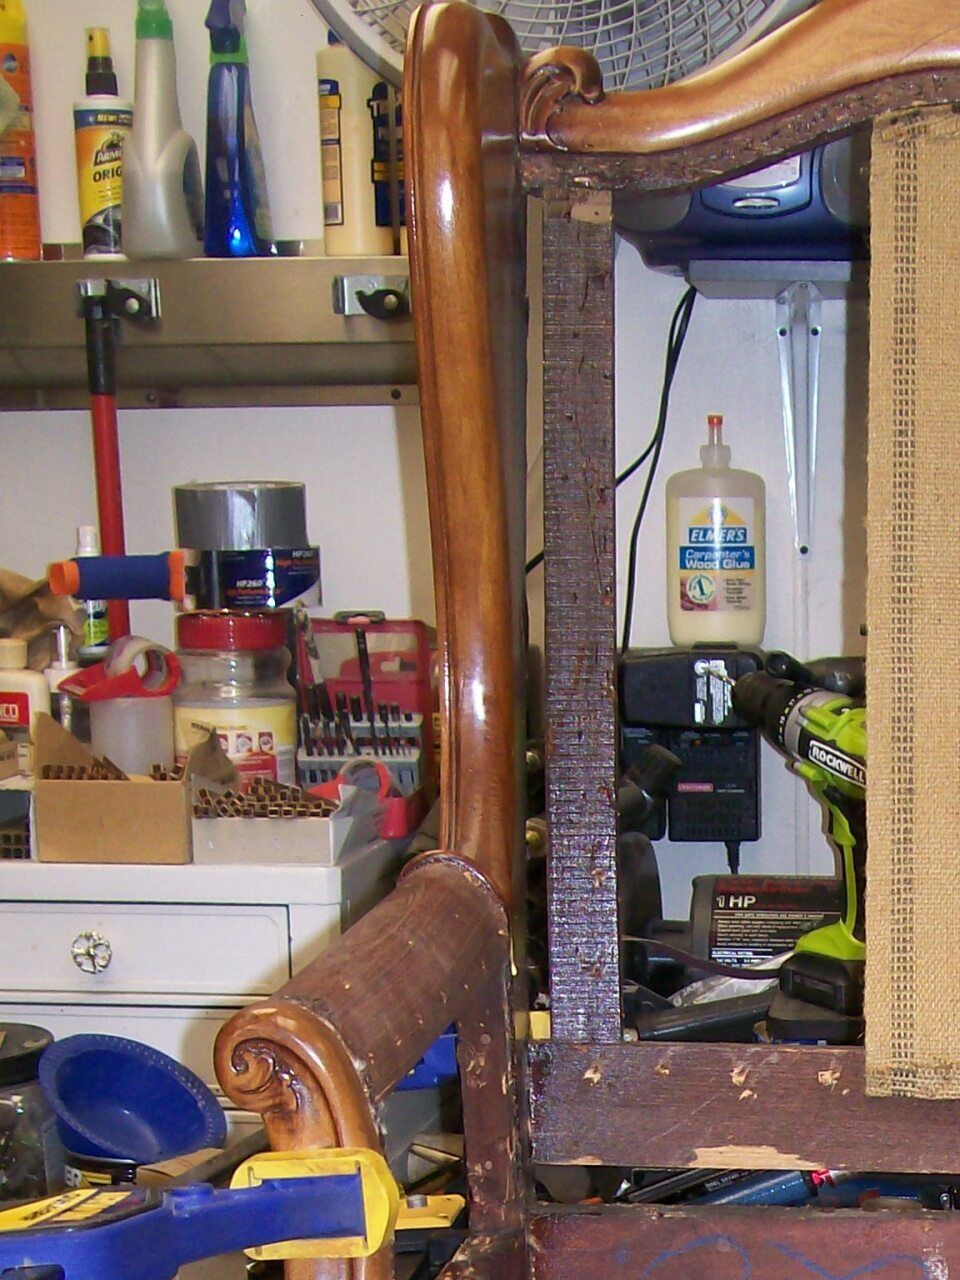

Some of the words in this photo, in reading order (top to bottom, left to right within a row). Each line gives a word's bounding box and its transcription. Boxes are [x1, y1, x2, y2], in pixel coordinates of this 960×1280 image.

[691, 528, 745, 542] ELMER'S
[685, 549, 751, 562] Carpenter's
[685, 559, 720, 570] Wood
[722, 558, 751, 570] Glue
[812, 745, 865, 783] ROCKWELL
[729, 895, 756, 908] HP
